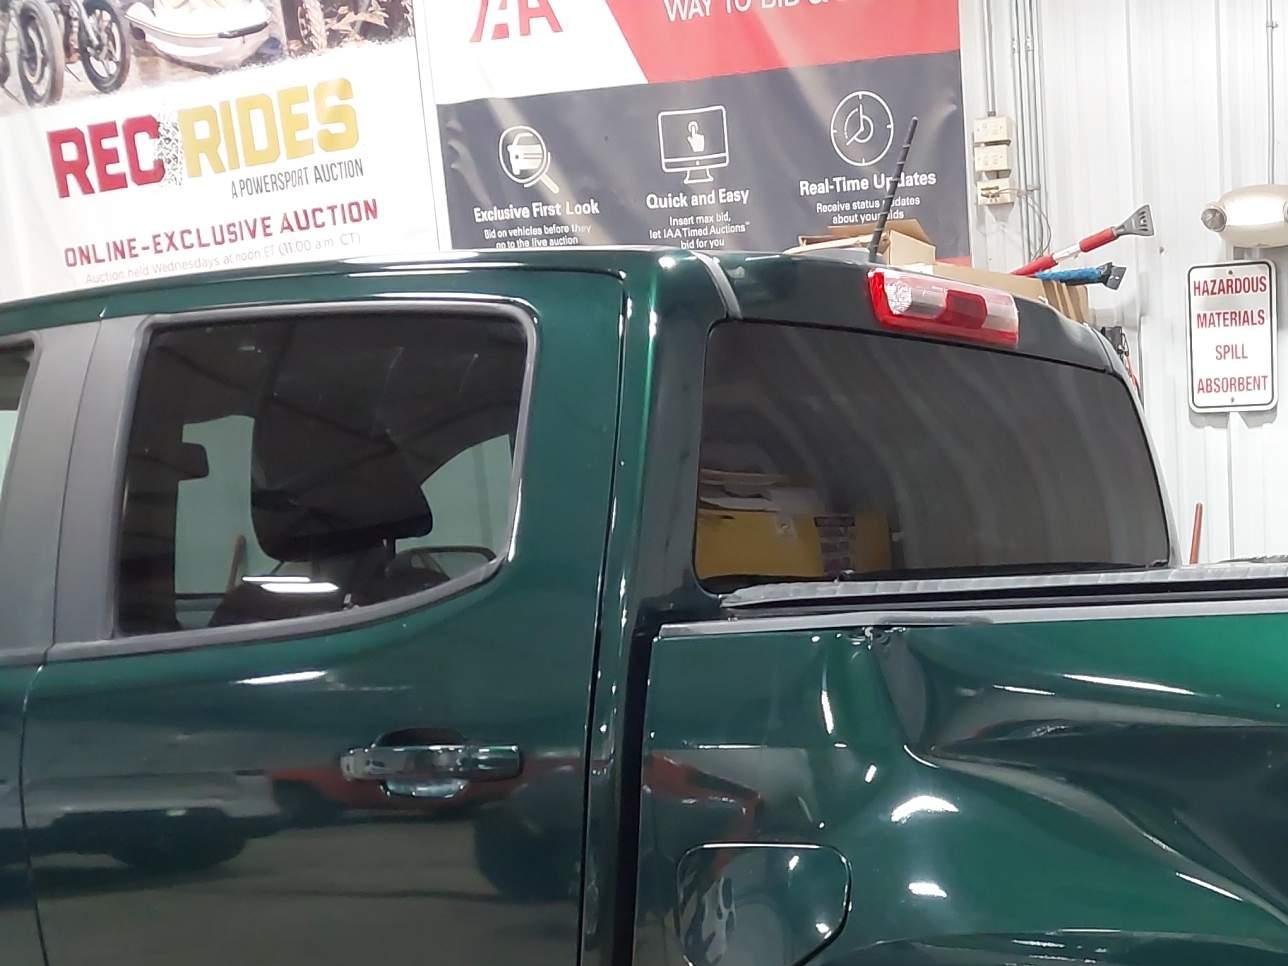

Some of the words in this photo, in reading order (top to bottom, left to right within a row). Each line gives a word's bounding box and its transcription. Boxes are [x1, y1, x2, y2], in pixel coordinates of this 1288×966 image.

[664, 0, 711, 22] WAY
[46, 113, 166, 199] REC
[177, 77, 359, 178] RIDES
[231, 180, 239, 199] A
[239, 168, 310, 199] POWERSPORT
[313, 158, 364, 186] AUCTION
[799, 175, 870, 196] Real-Time
[646, 192, 689, 209] Quick
[691, 189, 716, 206] and
[718, 187, 749, 204] Easy
[816, 200, 850, 213] Receive
[852, 199, 880, 210] status
[473, 203, 530, 222] Exclusive
[531, 200, 562, 218] First
[564, 198, 600, 215] Look
[669, 216, 694, 226] Insert
[695, 215, 714, 223] max
[715, 211, 731, 222] bid,
[832, 214, 859, 224] about
[64, 215, 274, 268] ONLINE-EXCLUSIVE
[279, 198, 379, 234] AUCTION
[484, 229, 497, 240] Bid
[508, 225, 543, 236] vehicles
[543, 223, 570, 235] before
[507, 239, 516, 248] to
[516, 237, 530, 248] the
[531, 236, 548, 247] live
[549, 234, 579, 246] auction
[650, 229, 662, 240] let
[663, 228, 682, 239] IAA
[682, 226, 708, 237] Timed
[681, 240, 695, 250] bid
[696, 239, 708, 249] for
[709, 238, 725, 249] you
[1193, 275, 1268, 297] HAZARDOUS
[1196, 309, 1266, 329] MATERIALS
[1215, 343, 1249, 361] SPILL
[1196, 375, 1269, 394] ABSORBENT
